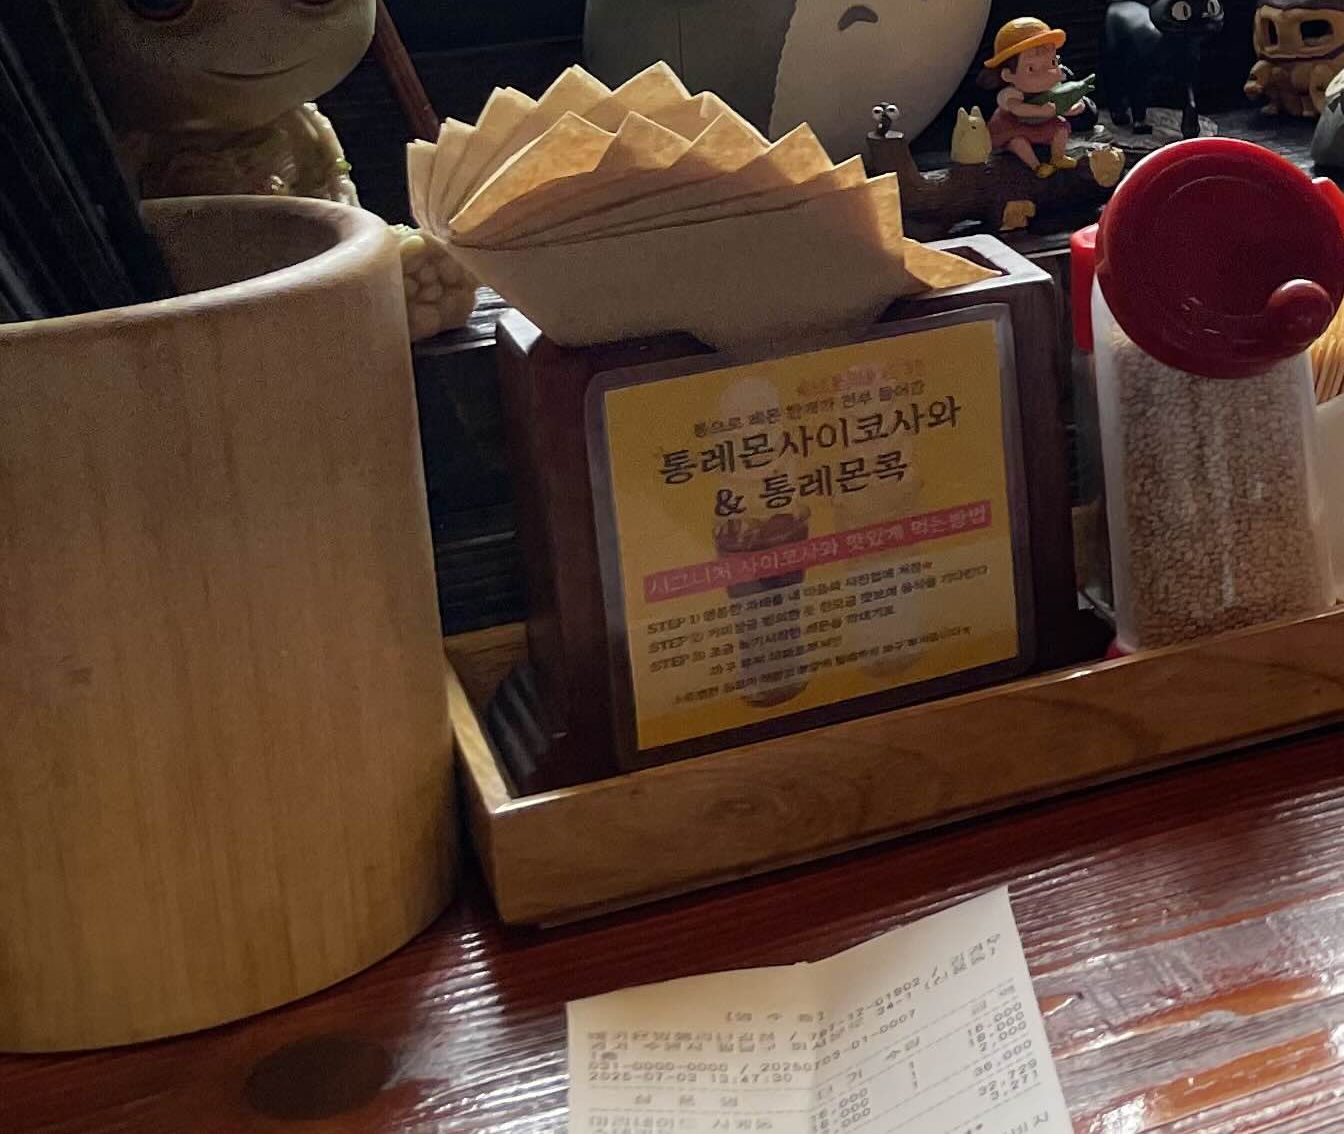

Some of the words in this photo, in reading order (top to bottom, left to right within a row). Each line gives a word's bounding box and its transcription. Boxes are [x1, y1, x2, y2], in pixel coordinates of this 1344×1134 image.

[660, 395, 962, 485] 통레몬사이코사와
[714, 488, 748, 517] &
[759, 450, 909, 510] 통레몬콕
